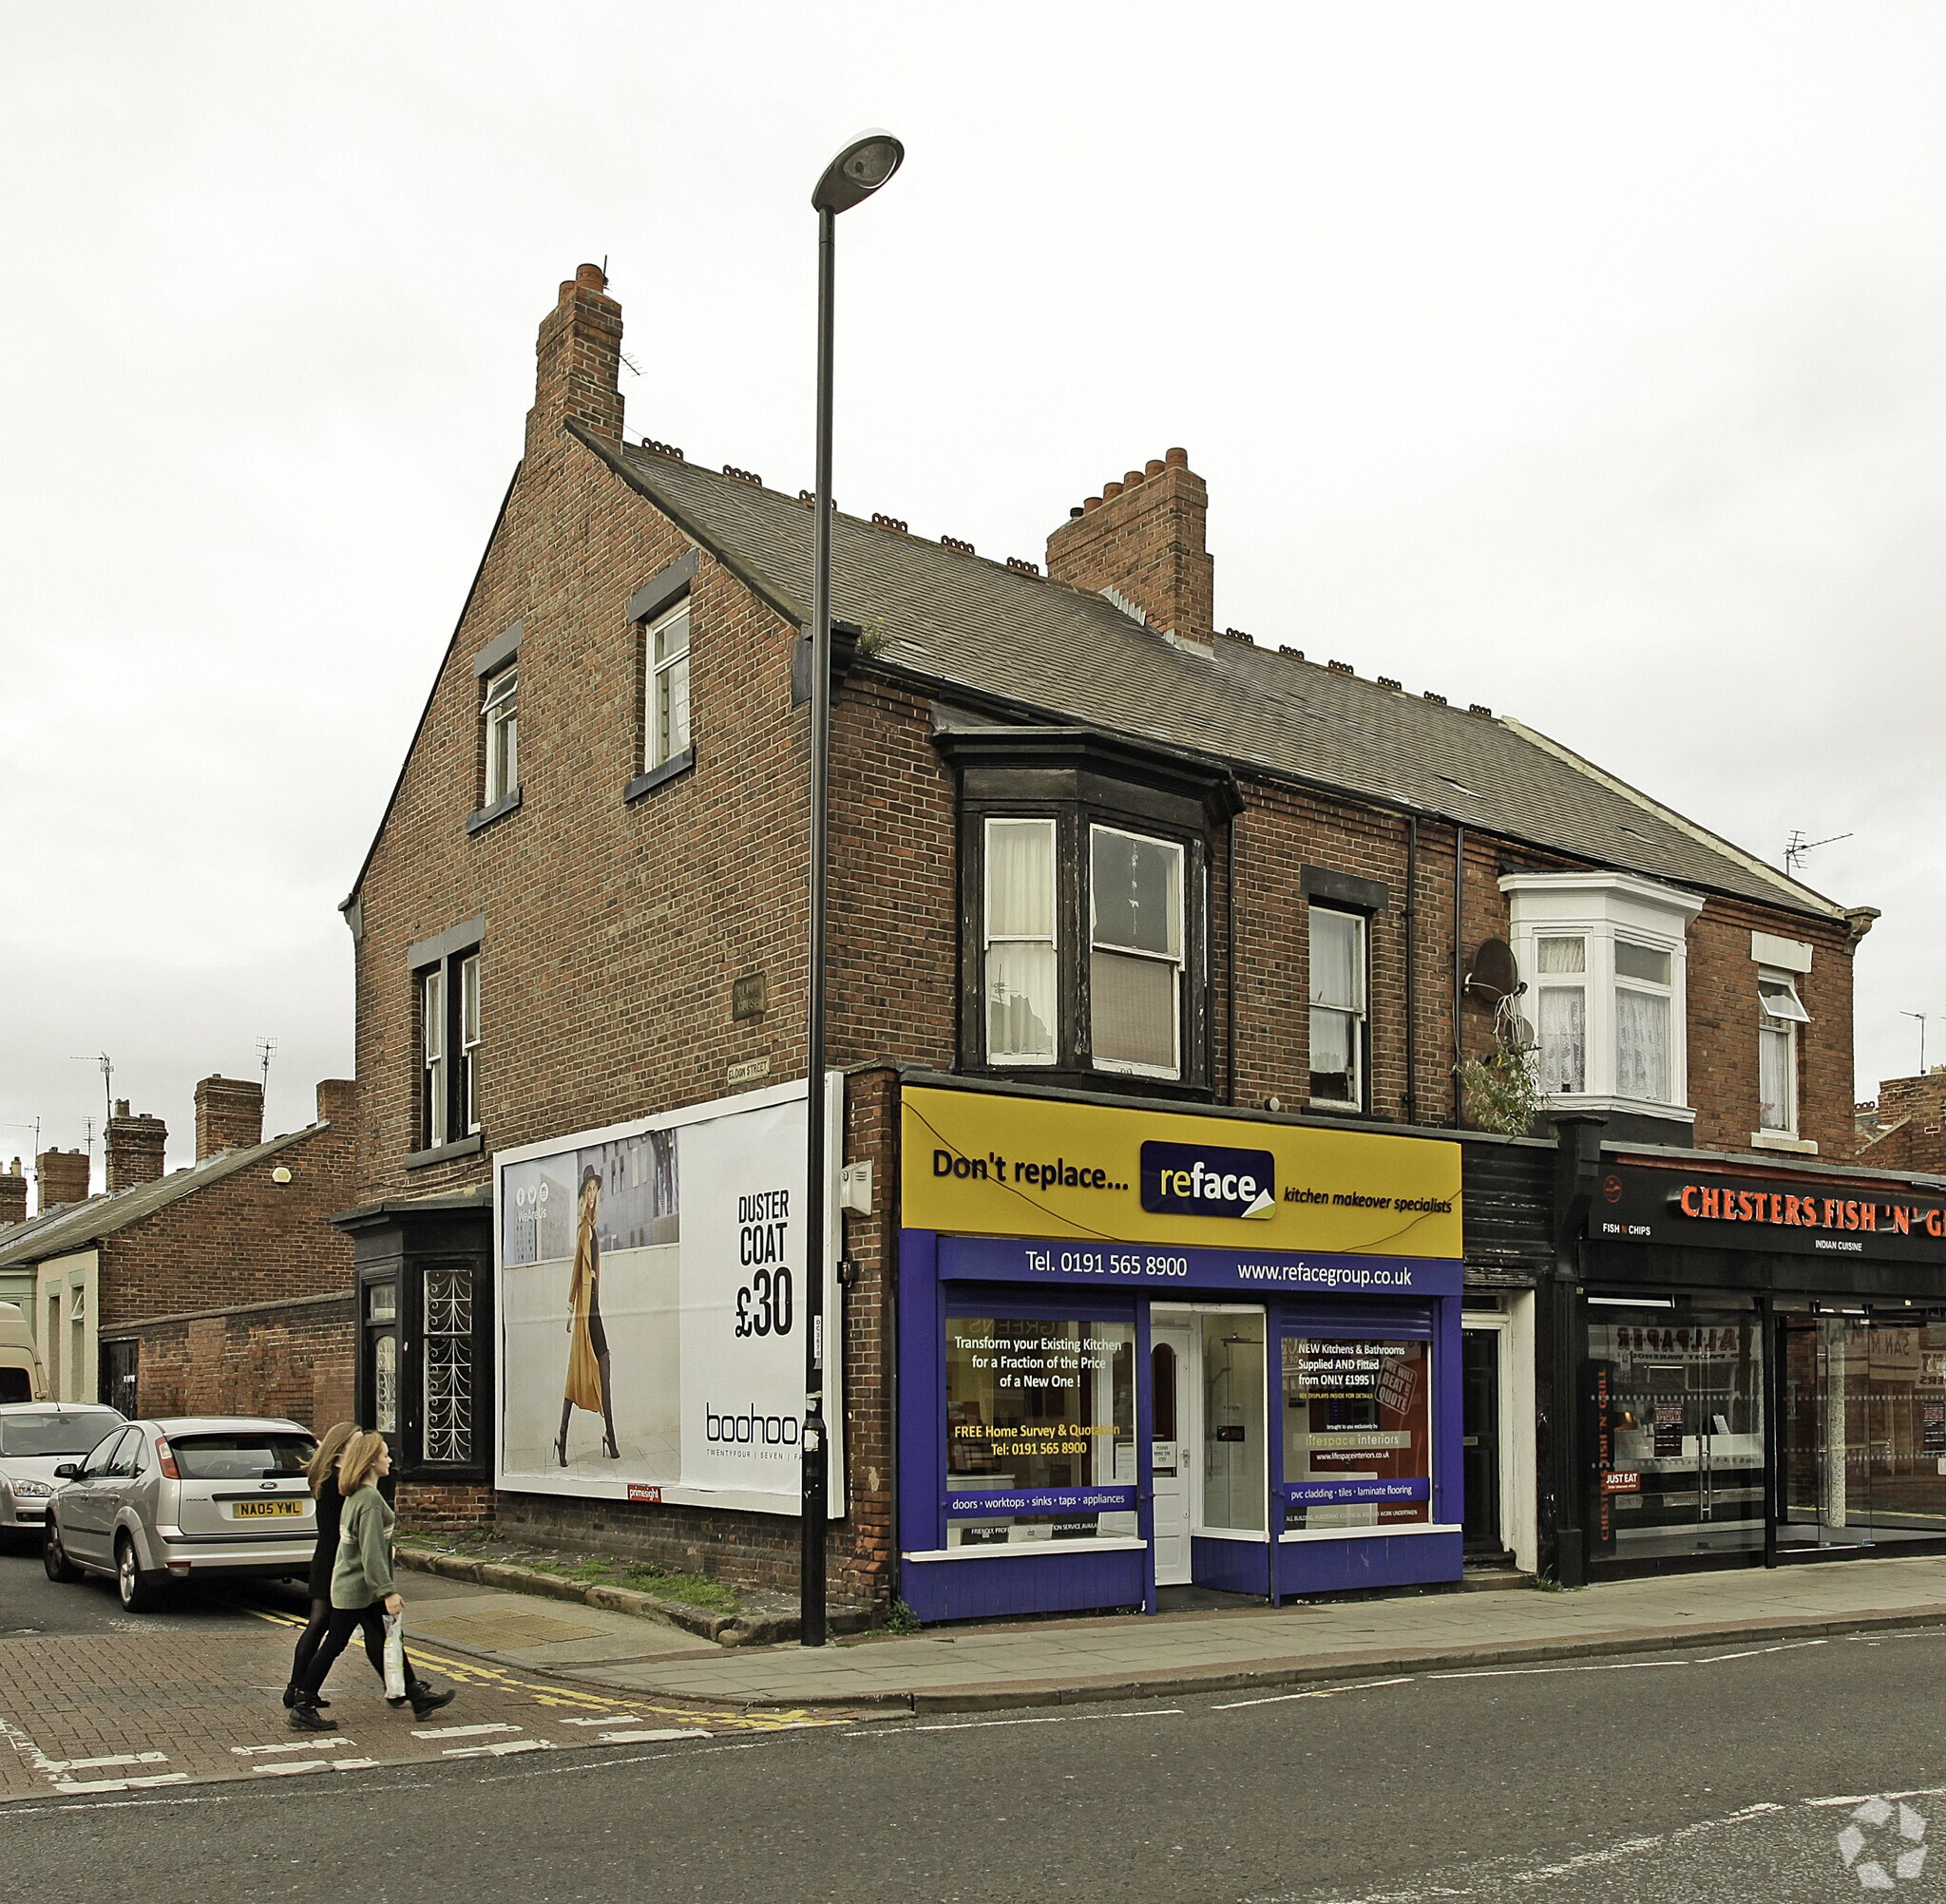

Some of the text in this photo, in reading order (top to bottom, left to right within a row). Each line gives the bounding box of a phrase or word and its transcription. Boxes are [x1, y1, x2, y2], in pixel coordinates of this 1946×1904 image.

[747, 1061, 768, 1076] STREET
[933, 1149, 1129, 1190] Don't replace...
[1160, 1161, 1257, 1202] reface
[738, 1190, 789, 1224] DUSTER
[1284, 1186, 1452, 1214] kitchen makeover specialists
[1680, 1185, 1817, 1228] CHESTERS
[1822, 1197, 1876, 1232] FISH
[1926, 1209, 1946, 1237] G
[1602, 1223, 1620, 1233] FISH
[1629, 1225, 1651, 1236] CHIPS
[740, 1222, 788, 1266] COAT
[1816, 1239, 1862, 1252] INDIAN CUISINE
[1025, 1250, 1188, 1277] Tel. 0191 565 8900
[1237, 1262, 1412, 1287] www.refacegroup.co.uk
[735, 1266, 792, 1338] £30
[955, 1336, 1122, 1353] Transform your Existing Kitchen
[1298, 1343, 1405, 1355] NEW Kitchens & Bathrooms
[972, 1355, 1106, 1369] for a Fraction of the Price
[1298, 1359, 1380, 1371] Supplied AND Fitted
[1000, 1374, 1011, 1388] of
[1014, 1377, 1021, 1387] a
[1023, 1375, 1048, 1387] New
[1051, 1375, 1074, 1387] One
[1298, 1374, 1319, 1385] from
[1320, 1374, 1344, 1385] ONLY
[1345, 1374, 1369, 1385] £1995
[1383, 1371, 1404, 1393] BEAT
[1398, 1365, 1414, 1384] WILL
[1379, 1386, 1408, 1412] QUOTE
[706, 1401, 801, 1445] boohoo.
[954, 1426, 983, 1438] FREE
[985, 1425, 1018, 1438] Home
[1020, 1424, 1056, 1439] Survey
[1058, 1424, 1067, 1437] &
[1306, 1433, 1399, 1447] lifespace interiors
[706, 1448, 751, 1458] TWENTYFOUR
[760, 1451, 783, 1460] SEVEN
[991, 1441, 1087, 1456] Tel: 0191 565 8900
[1606, 1473, 1638, 1484] JUST EAT
[629, 1486, 659, 1501] primesight
[1290, 1485, 1413, 1501] pvc cladding tiles laminate flooring
[240, 1502, 300, 1515] NA05 YWL
[952, 1494, 1125, 1511] doors worktops sinks taps appliances
